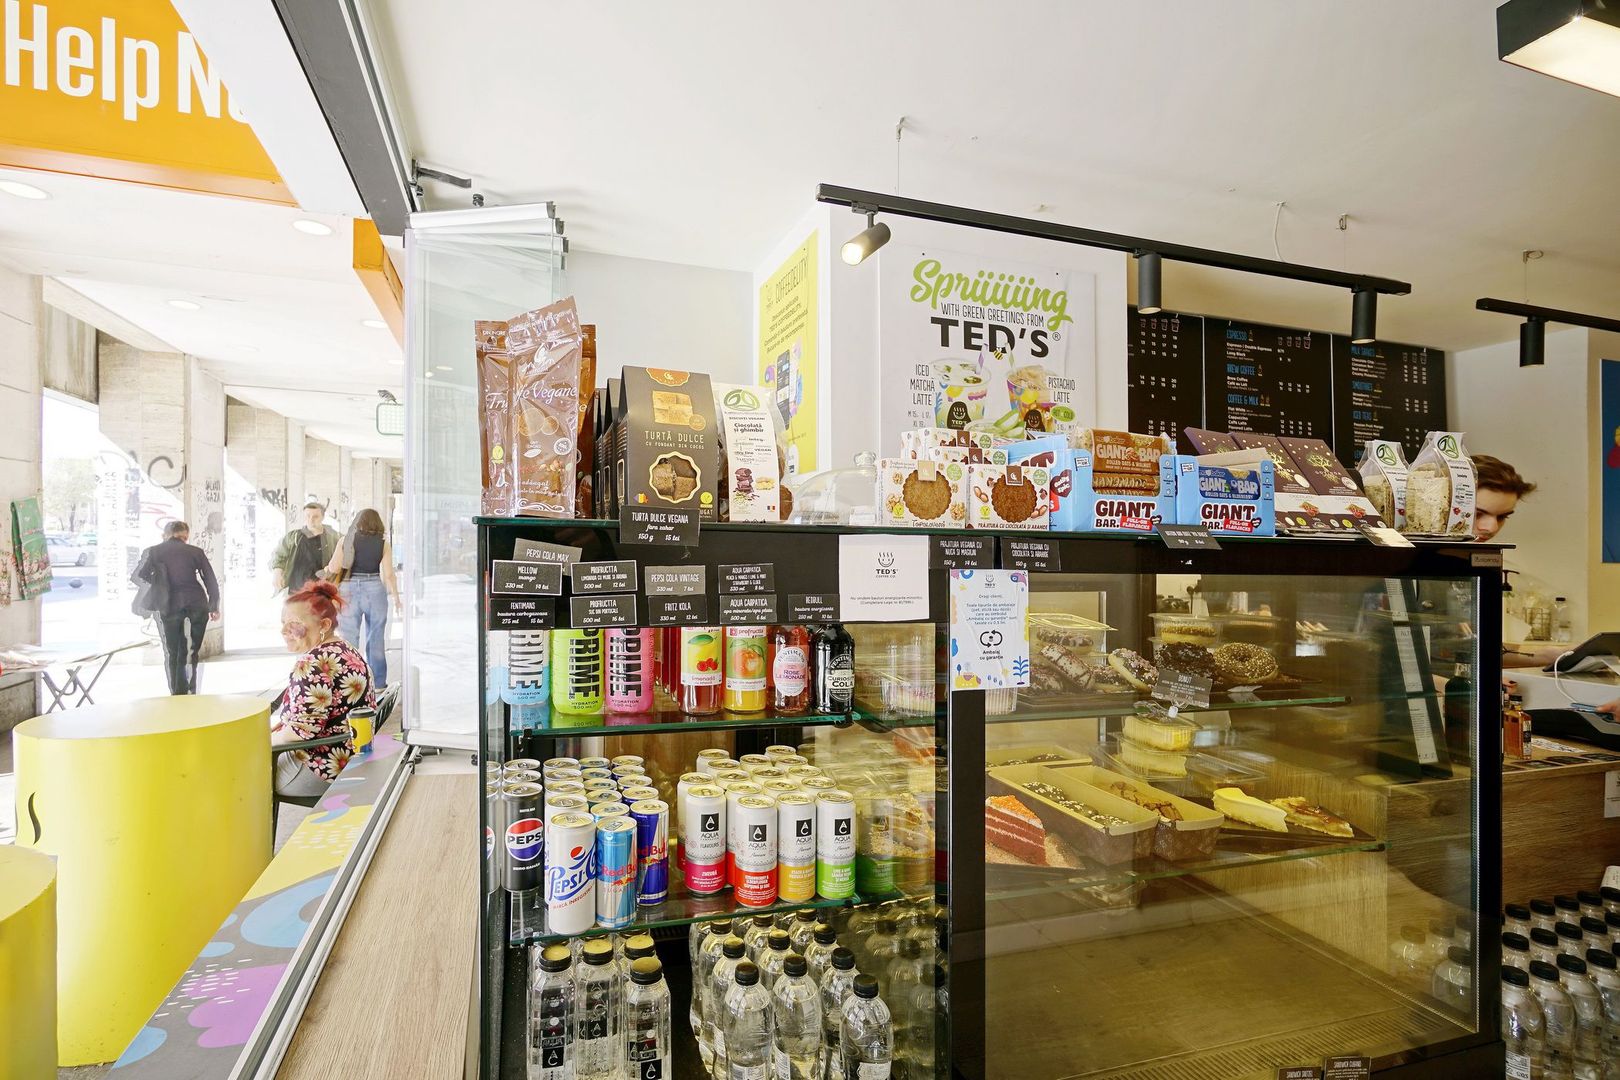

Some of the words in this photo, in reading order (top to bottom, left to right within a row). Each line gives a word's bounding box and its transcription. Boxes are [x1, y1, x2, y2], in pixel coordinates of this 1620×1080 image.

[5, 0, 160, 122] Help
[941, 303, 960, 317] WITH
[963, 305, 985, 320] GREEN
[988, 309, 1025, 325] GREETINGS
[1027, 314, 1045, 327] FROM
[931, 316, 1049, 358] TED'S
[916, 364, 930, 377] ICED
[910, 379, 935, 392] MATCHA
[1049, 377, 1076, 391] PISTACHIO
[532, 382, 577, 404] Vegane
[913, 393, 932, 406] LATTE
[1054, 391, 1070, 403] LATTE
[1228, 394, 1243, 404] COFFEE
[645, 430, 672, 442] TURTĂ
[678, 432, 704, 443] DULCE
[1096, 444, 1128, 460] GIANT
[1139, 448, 1161, 462] BAR
[1200, 478, 1227, 493] GIANT
[1238, 481, 1259, 494] BAR
[1096, 501, 1156, 518] GIANT
[1201, 504, 1255, 520] GIANT
[632, 511, 649, 522] TURTA
[650, 512, 667, 523] DULCE
[668, 513, 689, 524] VEGANA
[1096, 519, 1120, 528] BAR.
[647, 523, 660, 532] fara
[1201, 521, 1223, 530] BAR.
[638, 533, 649, 541] 150
[672, 534, 681, 542] lei
[940, 541, 959, 549] PRAJITURA
[960, 541, 976, 549] VEGANA
[526, 549, 541, 558] PEPSI
[543, 551, 556, 560] COLA
[557, 553, 569, 563] MAX
[518, 566, 538, 575] MELLOW
[651, 574, 665, 583] PEPSI
[666, 574, 678, 583] COLA
[680, 574, 700, 582] VINTAGE
[511, 602, 536, 610] FENTIMANS
[665, 603, 678, 612] FRITZ
[679, 602, 692, 611] KOLA
[730, 599, 744, 607] AQUA
[744, 599, 768, 607] CARPATICA
[509, 630, 544, 690] RIME
[507, 832, 543, 845] PEPS
[601, 864, 624, 876] Red
[627, 864, 637, 874] Bu
